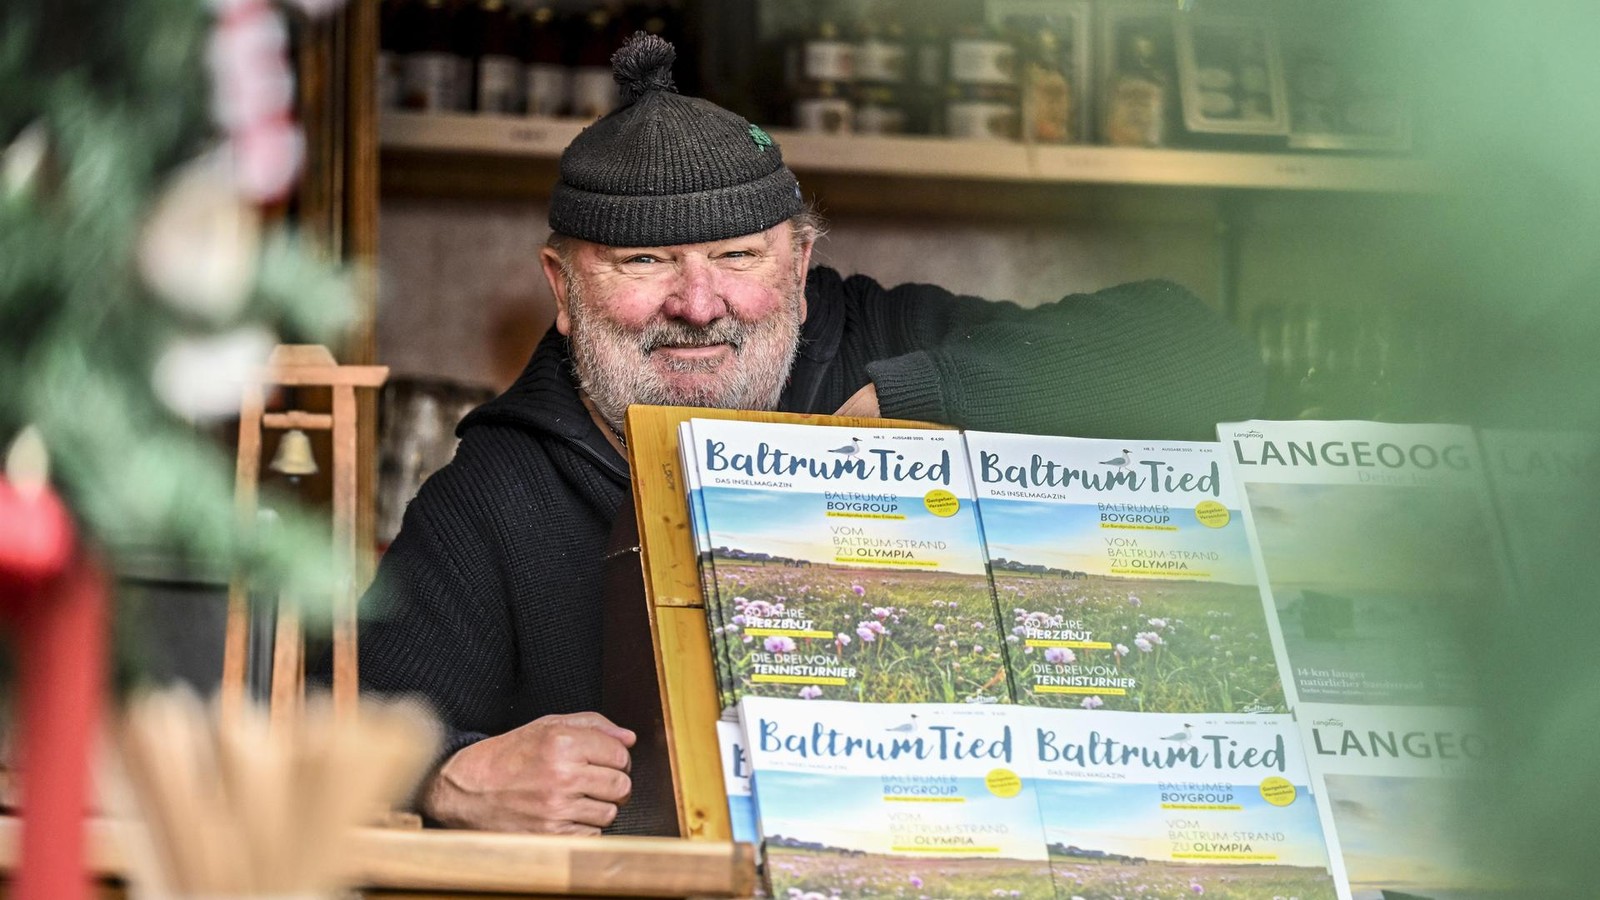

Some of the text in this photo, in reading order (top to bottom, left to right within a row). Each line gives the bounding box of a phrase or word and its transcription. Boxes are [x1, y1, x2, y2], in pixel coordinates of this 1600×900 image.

[1233, 439, 1473, 471] LANGEOOG
[715, 477, 793, 488] DAS INSELMAGAZIN
[824, 490, 898, 502] BALTRUMER
[1007, 491, 1066, 499] INSELMAGAZIN
[827, 502, 898, 512] BOYGROUP
[1098, 502, 1170, 513] BALTRUMER
[1100, 513, 1170, 524] BOYGROUP
[830, 525, 864, 536] VOM
[833, 536, 947, 550] BALTRUM-STRAND
[1105, 537, 1138, 547] VOM
[835, 547, 914, 559] ZU OLYMPIA
[1107, 547, 1220, 561] BALTRUM-STRAND
[1111, 558, 1188, 570] ZU OLYMPIA
[764, 608, 805, 618] JAHRE
[746, 618, 814, 630] HERZBLUT
[1024, 619, 1083, 630] 60 JAHRE
[1027, 630, 1092, 640] HERZBLUT
[752, 653, 839, 665] DIE DREI VOM
[754, 664, 857, 678] TENNISTURNIER
[1033, 664, 1119, 676] DIE DREI VOM
[1311, 668, 1329, 678] km
[1036, 675, 1136, 688] TENNISTURNIER
[883, 785, 958, 795] BOYGROUP
[1158, 782, 1233, 792] BALTRUMER
[1161, 793, 1234, 803] BOYGROUP
[1165, 820, 1200, 829] VOM
[914, 836, 975, 846] OLYMPIA
[1172, 842, 1252, 853] ZU OLYMPIA
